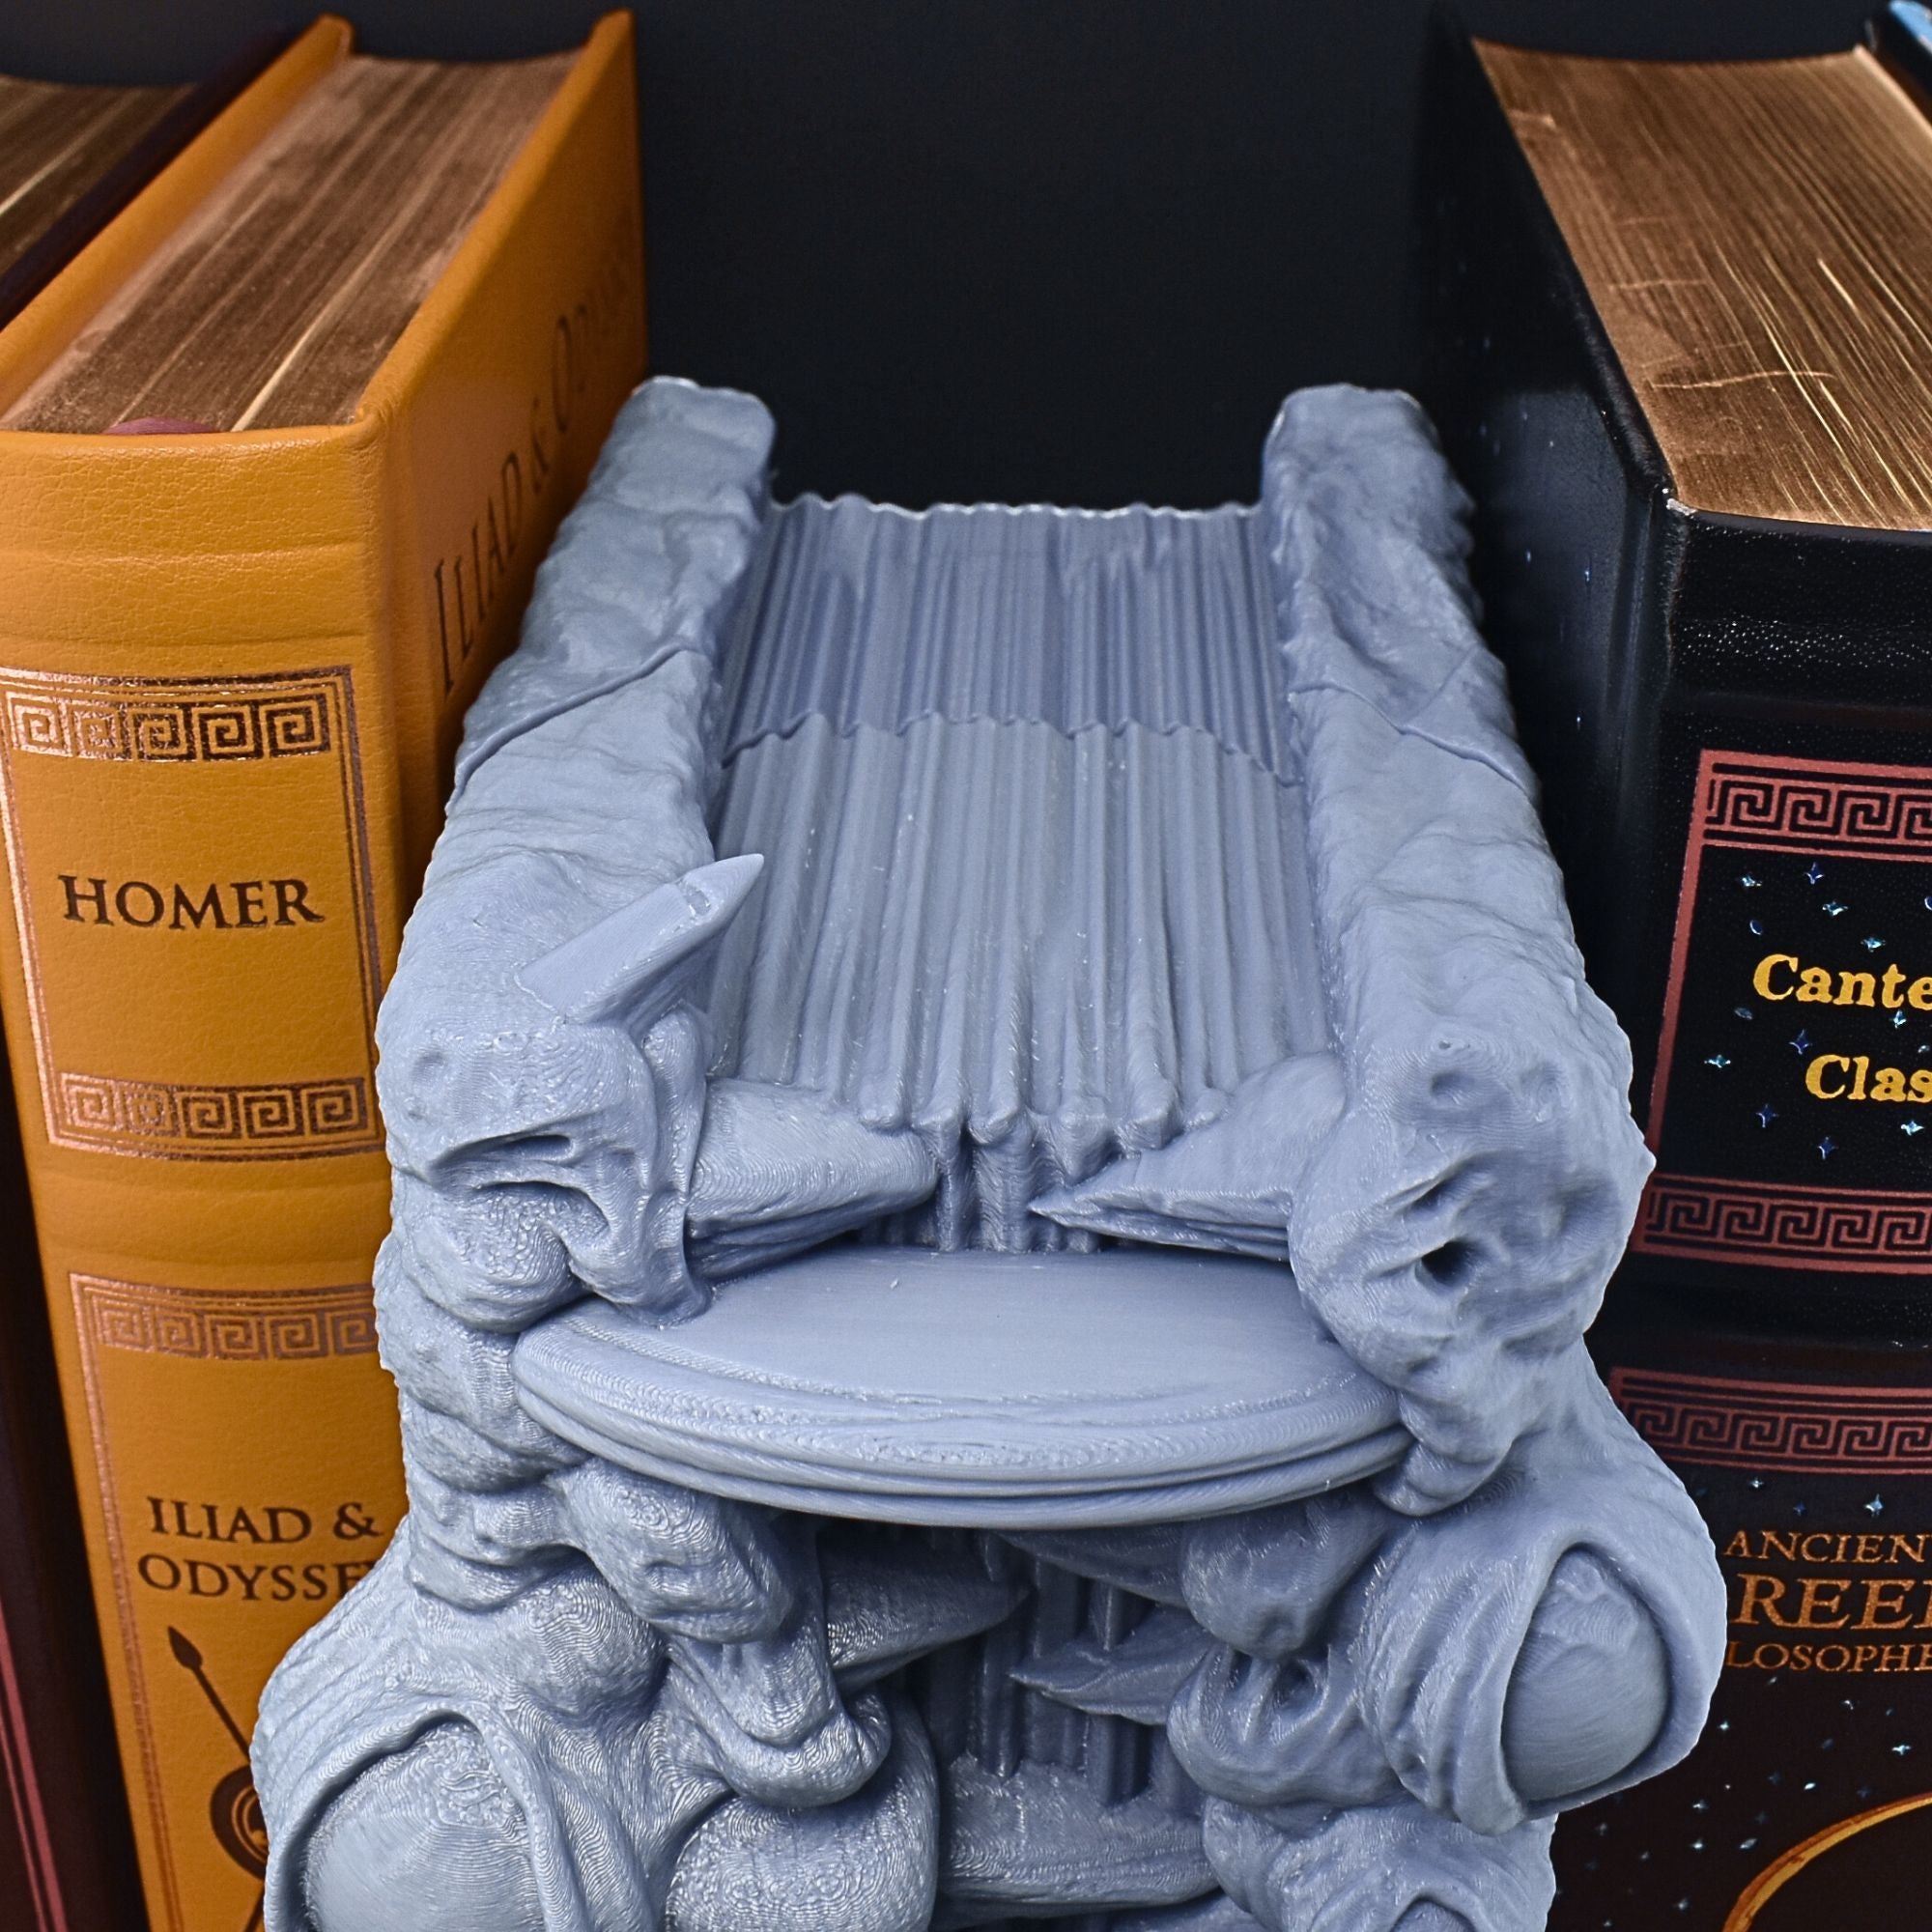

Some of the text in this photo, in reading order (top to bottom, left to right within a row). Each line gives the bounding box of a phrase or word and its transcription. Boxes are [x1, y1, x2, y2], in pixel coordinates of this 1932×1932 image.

[435, 451, 522, 697] ILIAD
[57, 873, 326, 930] HOMER
[1753, 953, 1932, 1010] Cante
[1805, 1054, 1932, 1103] Clas
[147, 1495, 384, 1544] ILIAD &
[137, 1553, 377, 1601] ODYSSE
